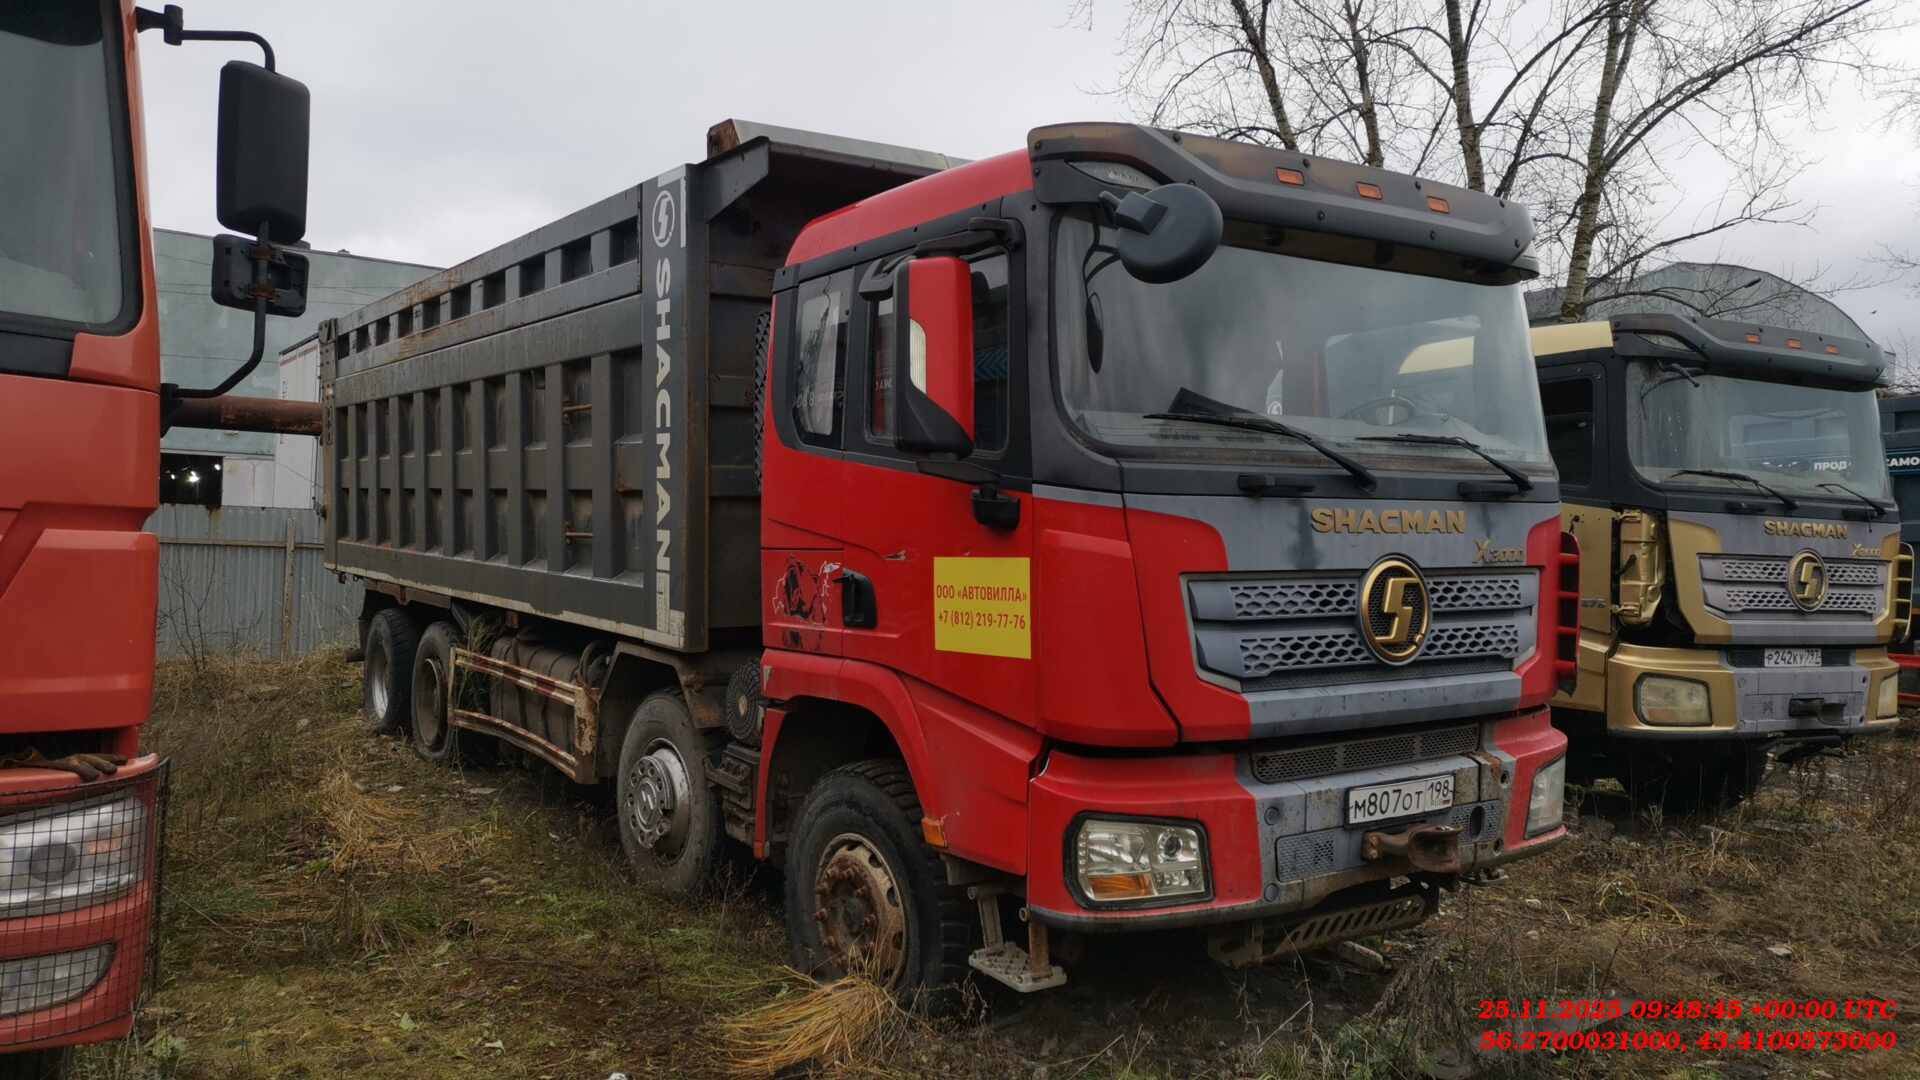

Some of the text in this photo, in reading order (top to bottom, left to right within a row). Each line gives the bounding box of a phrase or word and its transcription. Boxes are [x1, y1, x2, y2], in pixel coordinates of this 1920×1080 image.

[656, 257, 672, 573] SHACMAN
[1311, 508, 1466, 534] SHACMAN
[1764, 520, 1848, 540] SHACMAN
[936, 585, 1027, 602] ООО «АВТОВИЛЛА»
[938, 611, 1026, 630] +7 (812) 219-77-76
[1428, 780, 1450, 801] 198
